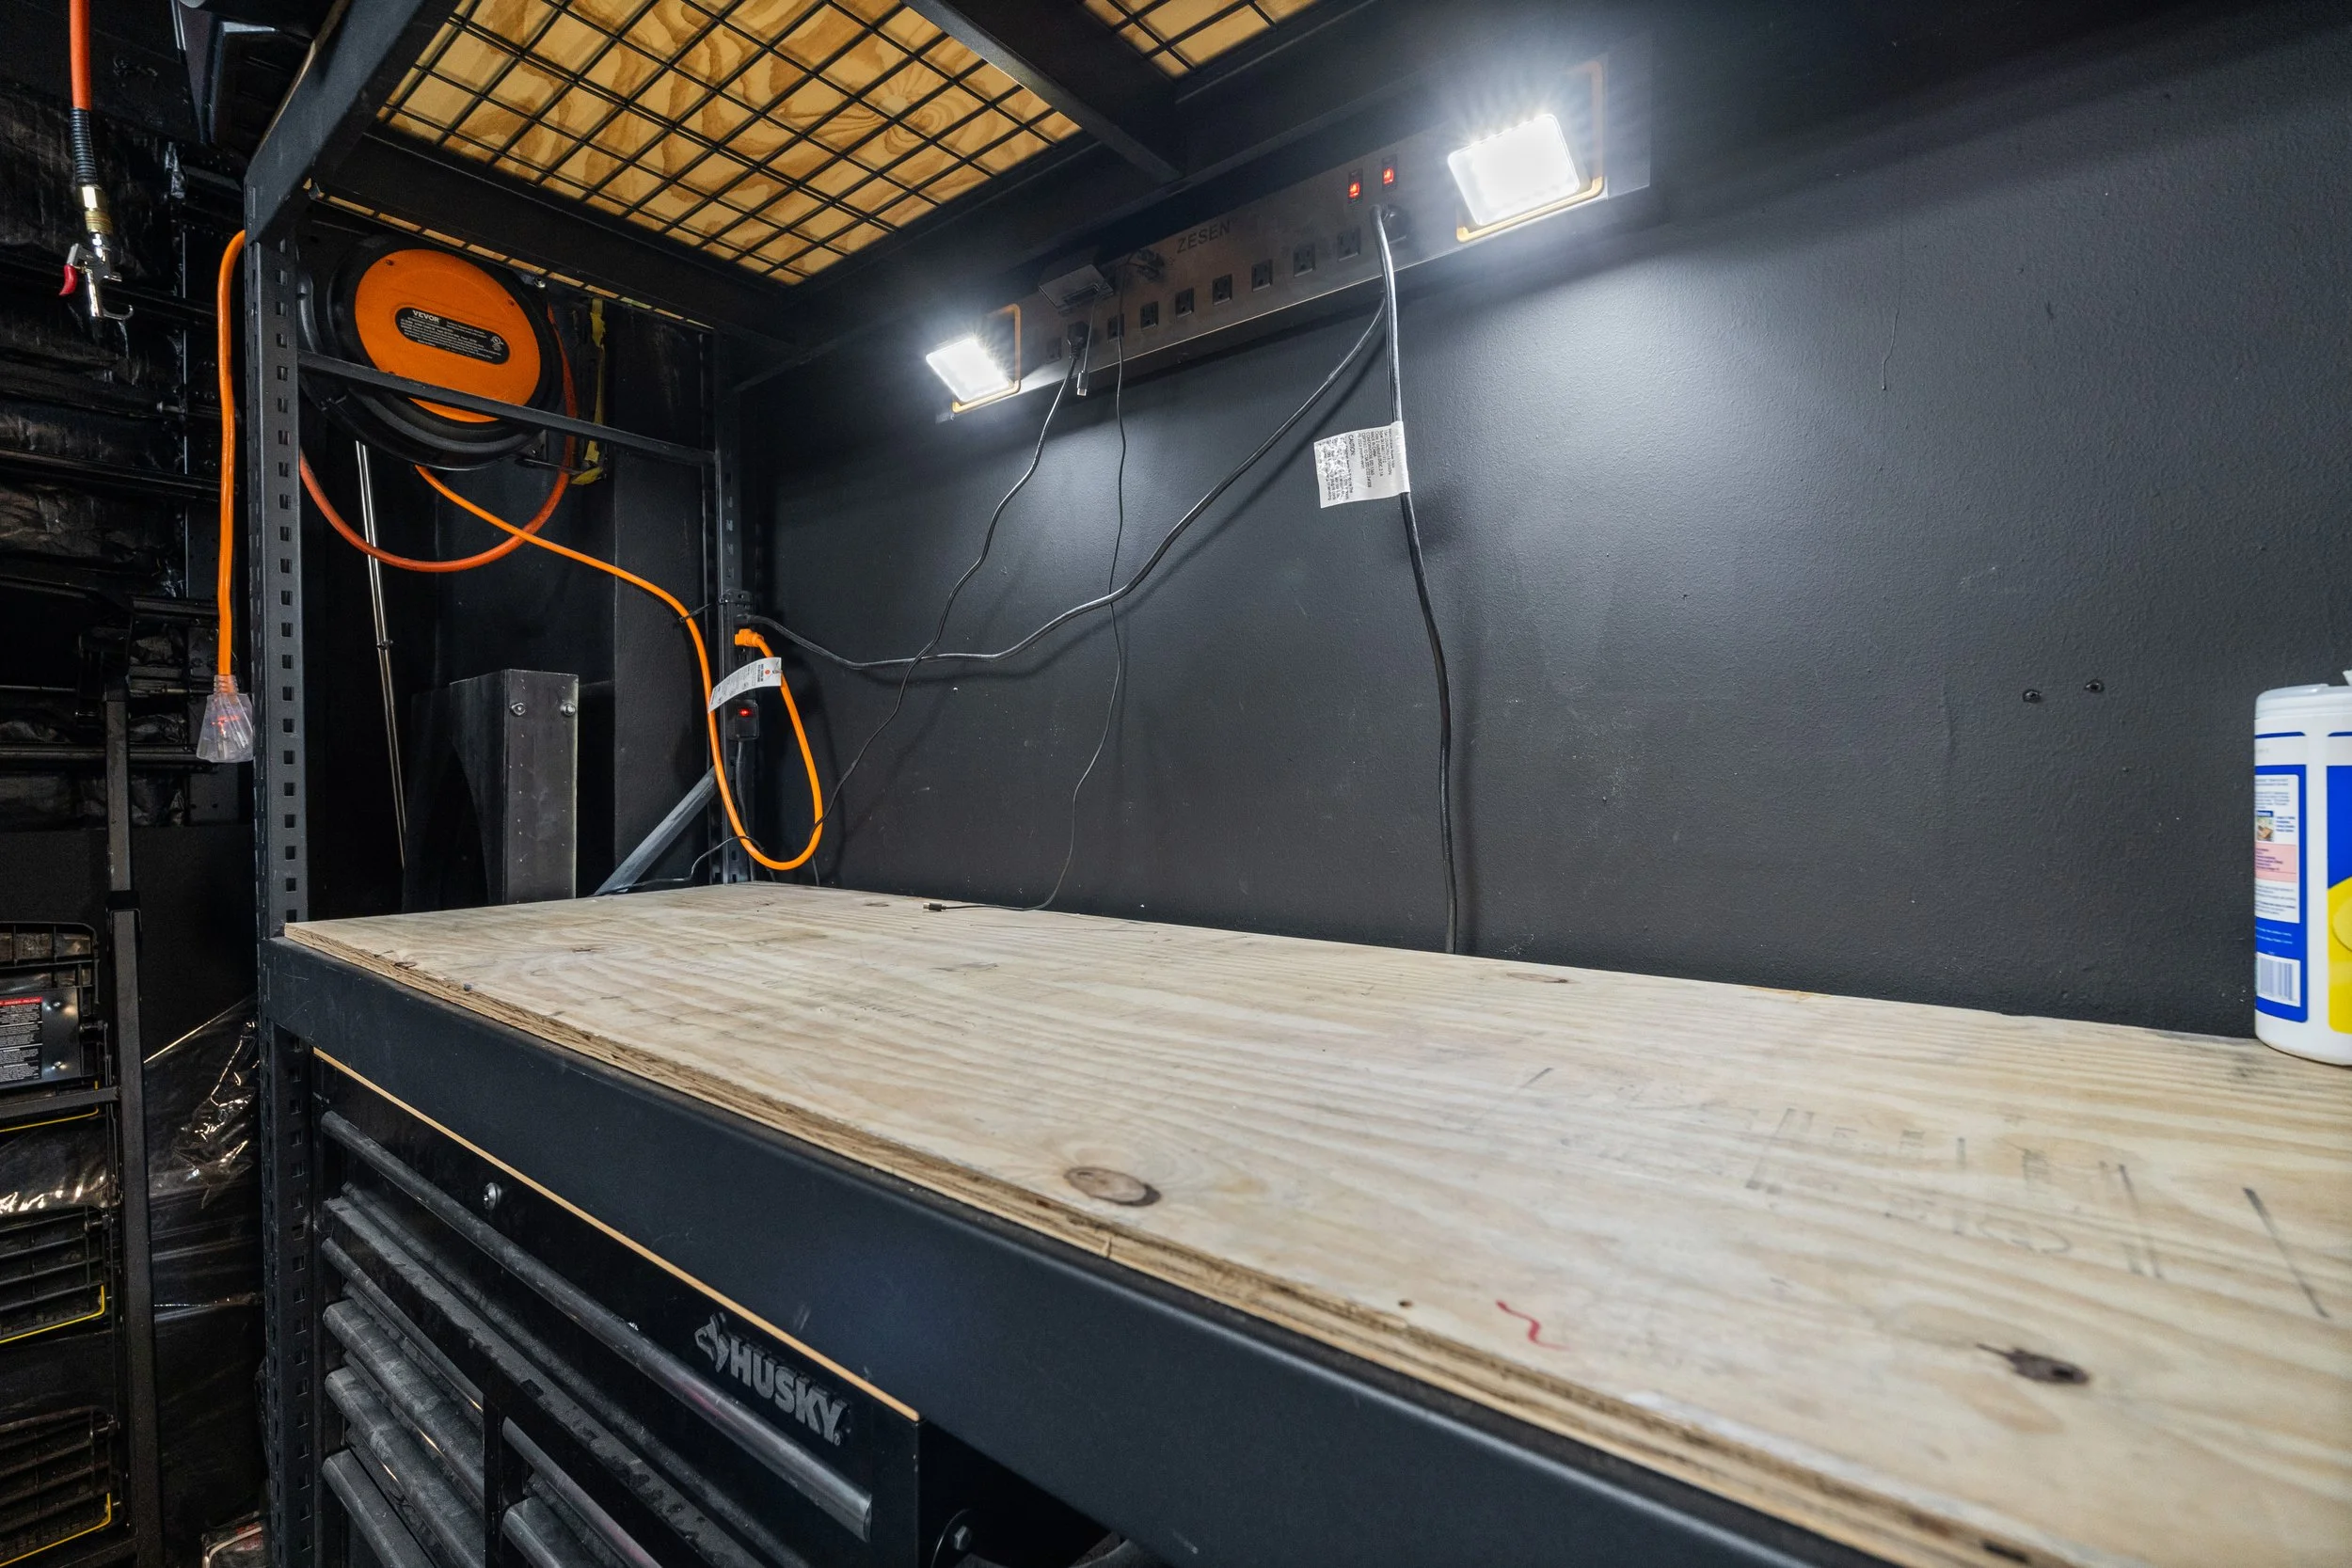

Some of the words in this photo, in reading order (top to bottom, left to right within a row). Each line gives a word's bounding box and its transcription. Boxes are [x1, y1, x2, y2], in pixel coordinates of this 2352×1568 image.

[1177, 219, 1232, 254] ZESEN
[412, 309, 439, 324] VEVOR
[729, 1338, 848, 1444] HUSKY
